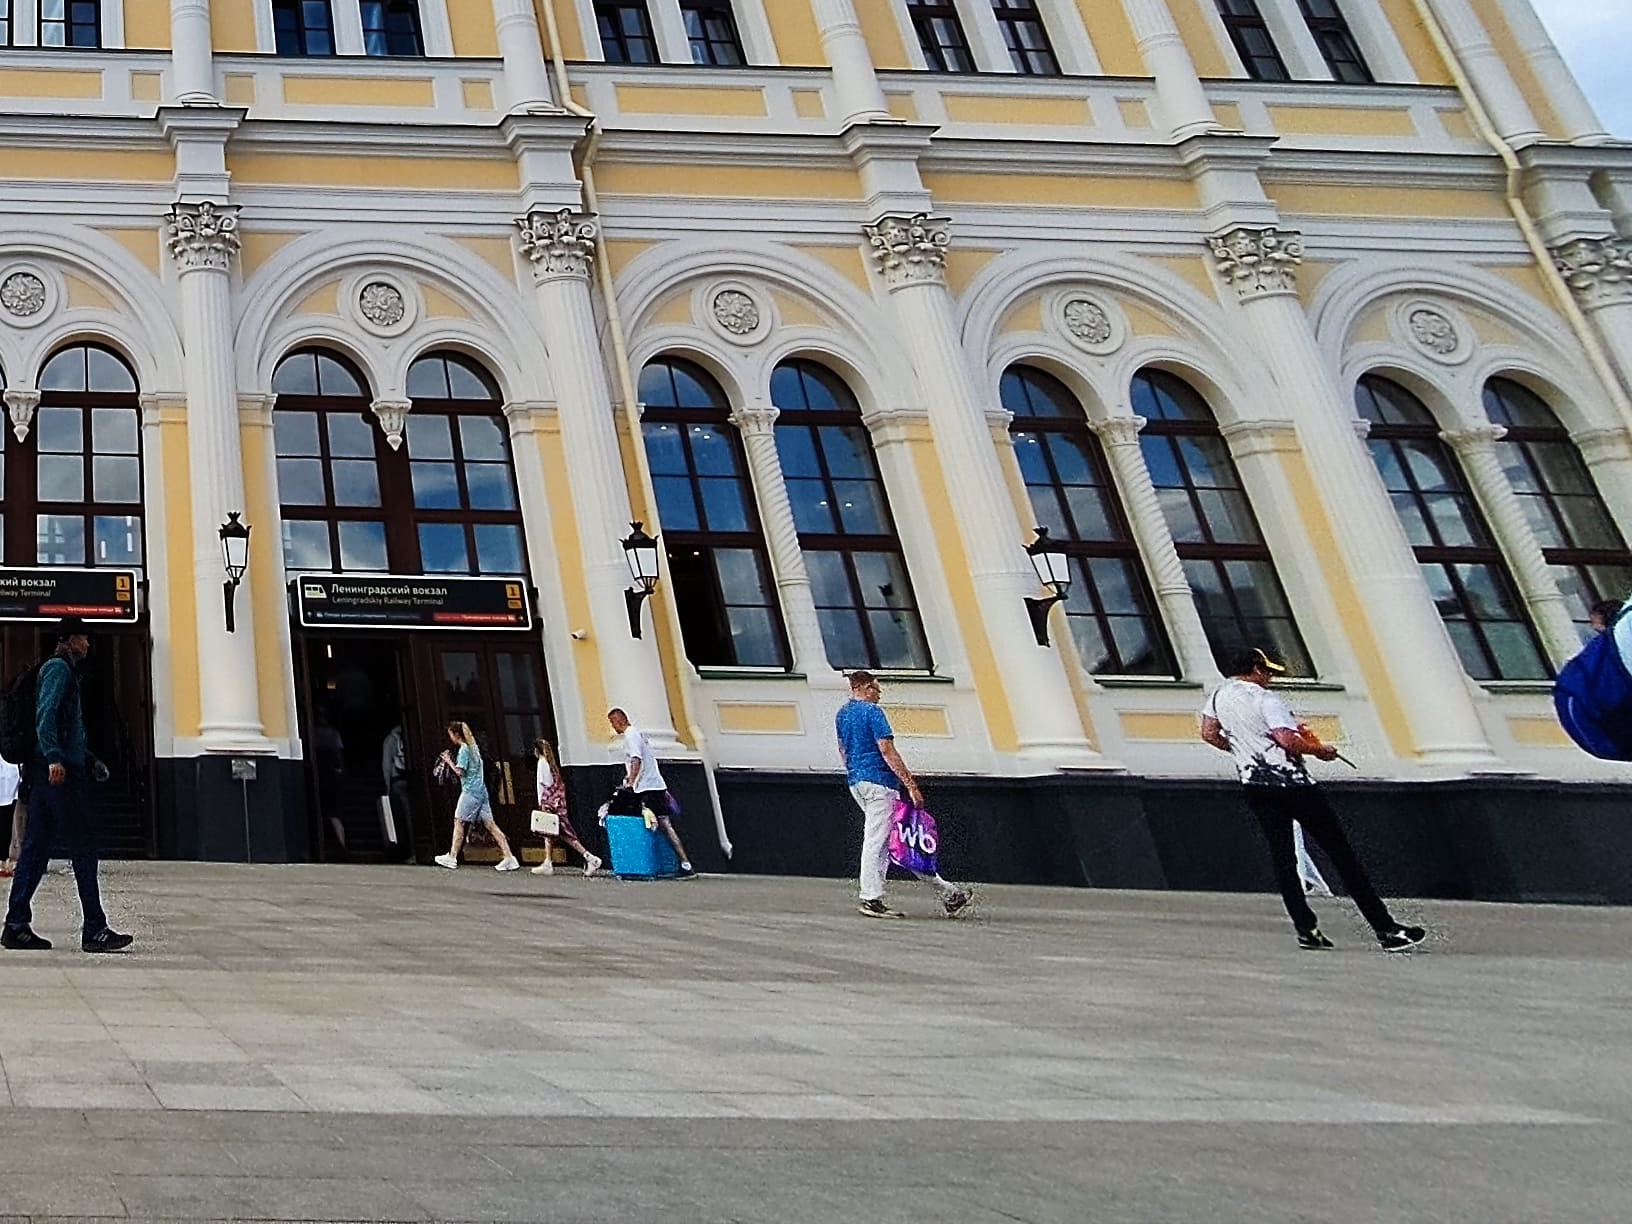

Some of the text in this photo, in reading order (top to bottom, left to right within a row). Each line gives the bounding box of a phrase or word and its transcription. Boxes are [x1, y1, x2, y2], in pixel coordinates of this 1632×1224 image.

[20, 579, 56, 587] вокзал
[331, 583, 448, 596] Ленинградский вокзал
[331, 596, 444, 606] Leningradskiy Railway Terminal
